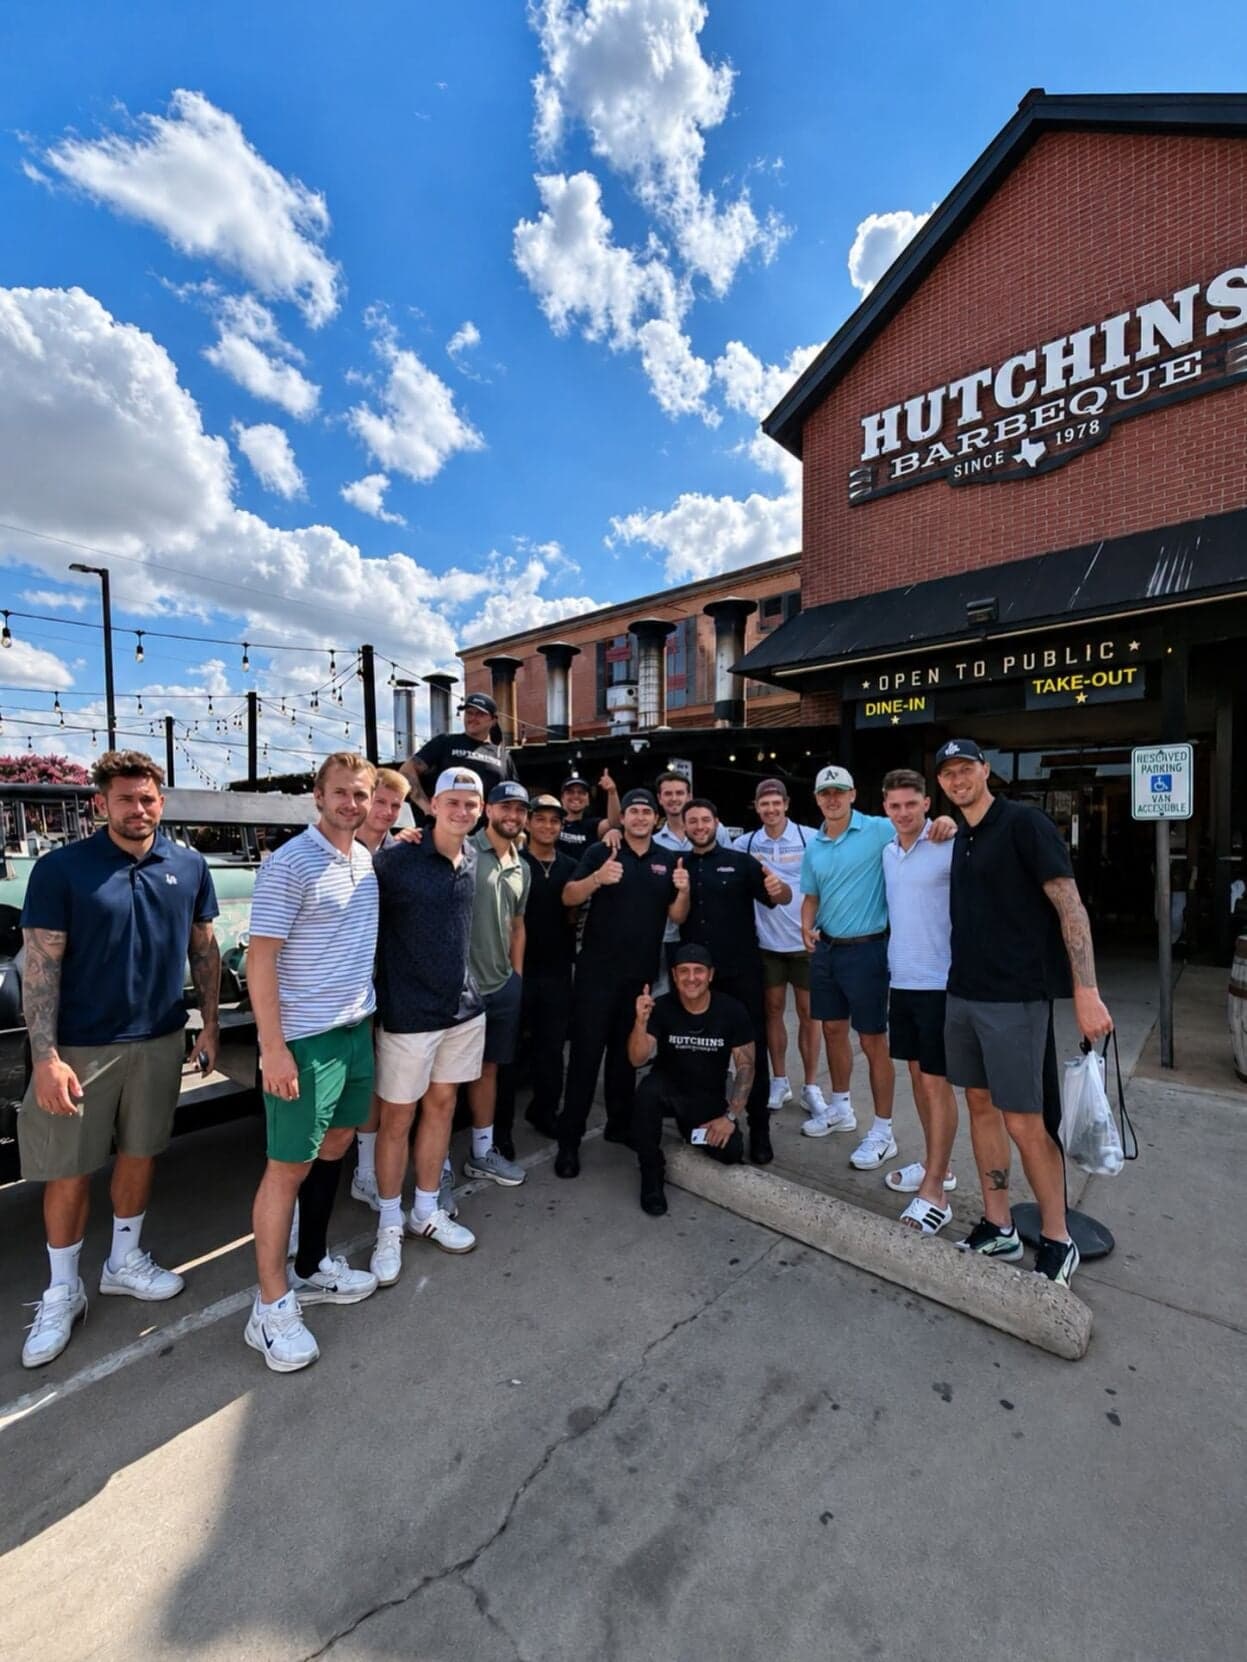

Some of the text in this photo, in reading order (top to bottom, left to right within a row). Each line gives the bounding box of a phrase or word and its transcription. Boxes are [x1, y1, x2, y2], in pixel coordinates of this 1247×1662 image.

[861, 265, 1247, 461] HUTCHINS
[891, 350, 1202, 480] BARBEQUE
[953, 419, 1101, 478] SINCE 1978
[879, 641, 1115, 691] OPEN TO PUBLIC
[1032, 667, 1138, 694] TAKE-OUT
[865, 697, 926, 717] DINE-IN
[1141, 763, 1182, 775] PARKING
[1151, 794, 1172, 803] VAN
[668, 1034, 725, 1047] HUTCHINS
